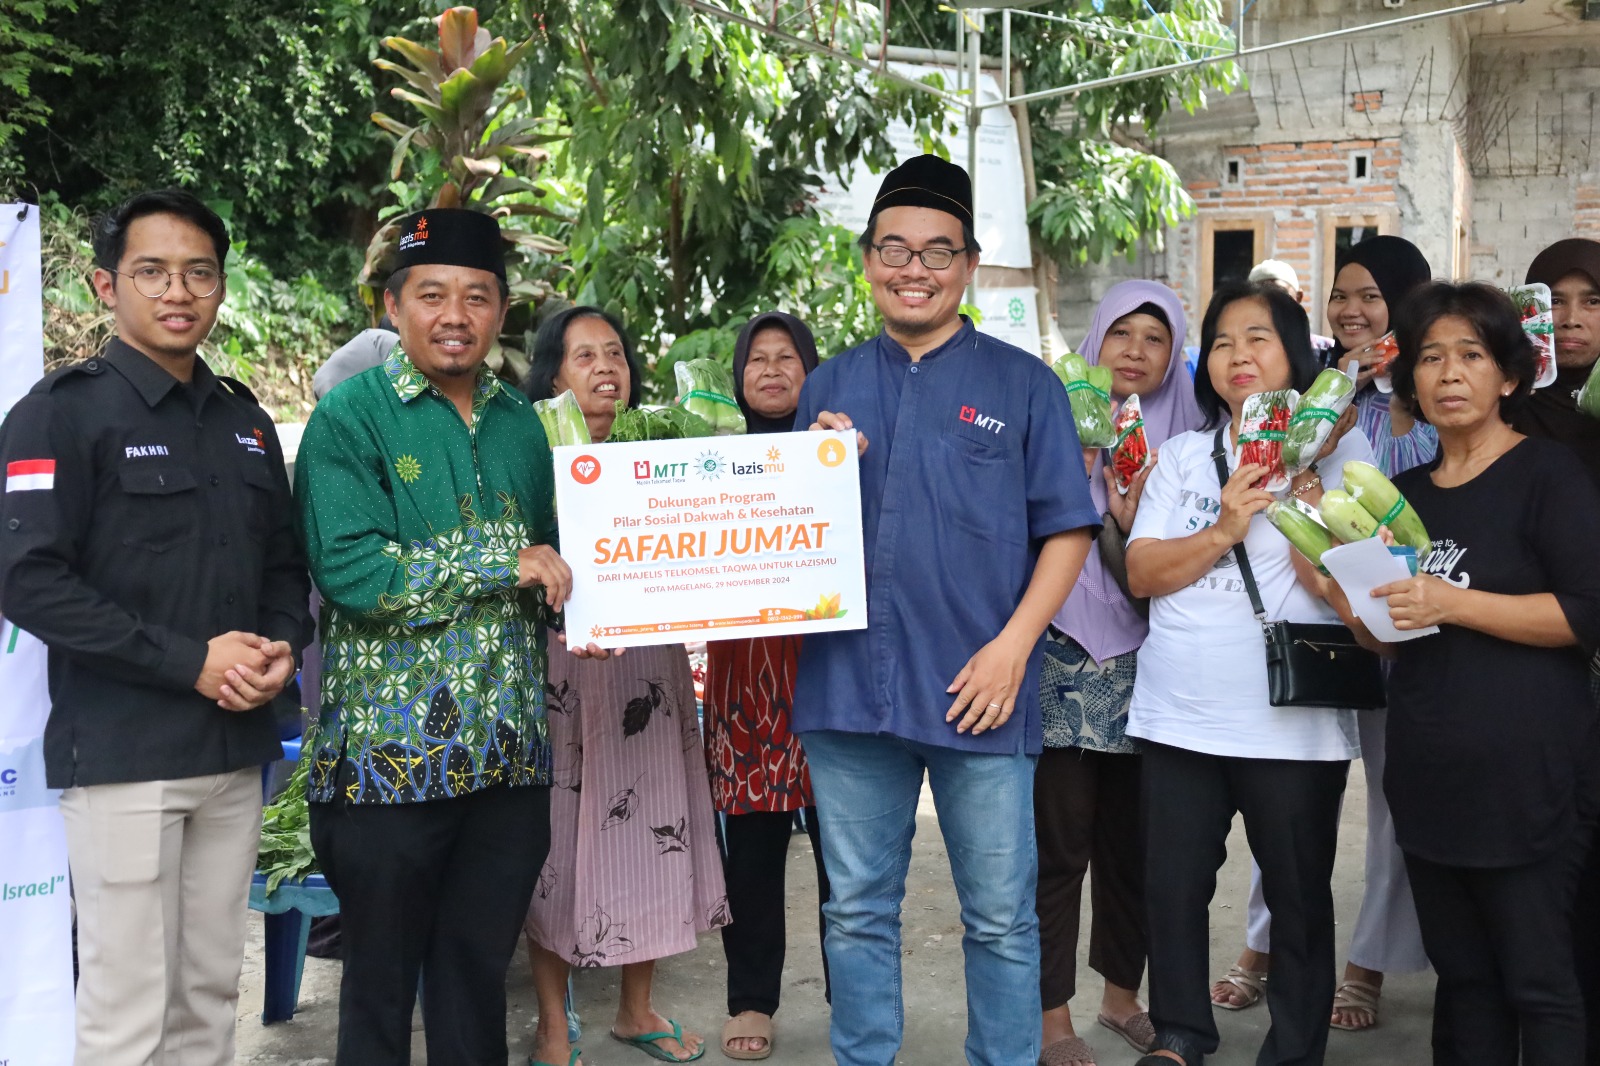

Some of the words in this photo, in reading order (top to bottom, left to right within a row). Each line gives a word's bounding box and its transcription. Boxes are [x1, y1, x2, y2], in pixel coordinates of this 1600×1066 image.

[974, 413, 1006, 434] MTT
[125, 445, 169, 459] FAKHRI
[653, 462, 689, 479] MTT
[732, 462, 785, 476] lazismu
[648, 496, 717, 509] Dukungan
[720, 492, 776, 505] Program
[613, 516, 642, 528] Pilar
[645, 512, 681, 526] Sosial
[684, 509, 735, 523] Dakwah
[737, 508, 747, 519] &
[751, 505, 814, 519] Kesehatan
[593, 531, 707, 565] SAFARI
[713, 522, 830, 556] JUM'AT
[597, 573, 621, 583] DARI
[623, 570, 663, 580] MAJELIS
[665, 566, 720, 578] TELKOMSEL
[722, 562, 758, 574] TAQWA
[759, 560, 793, 571] UNTUK
[795, 557, 837, 568] LAZISMU
[644, 585, 666, 594] KOTA
[667, 582, 714, 592] MAGELANG,
[715, 581, 724, 590] 29
[726, 577, 771, 587] NOVEMBER
[772, 576, 791, 584] 2024
[3, 875, 65, 901] Israel"
